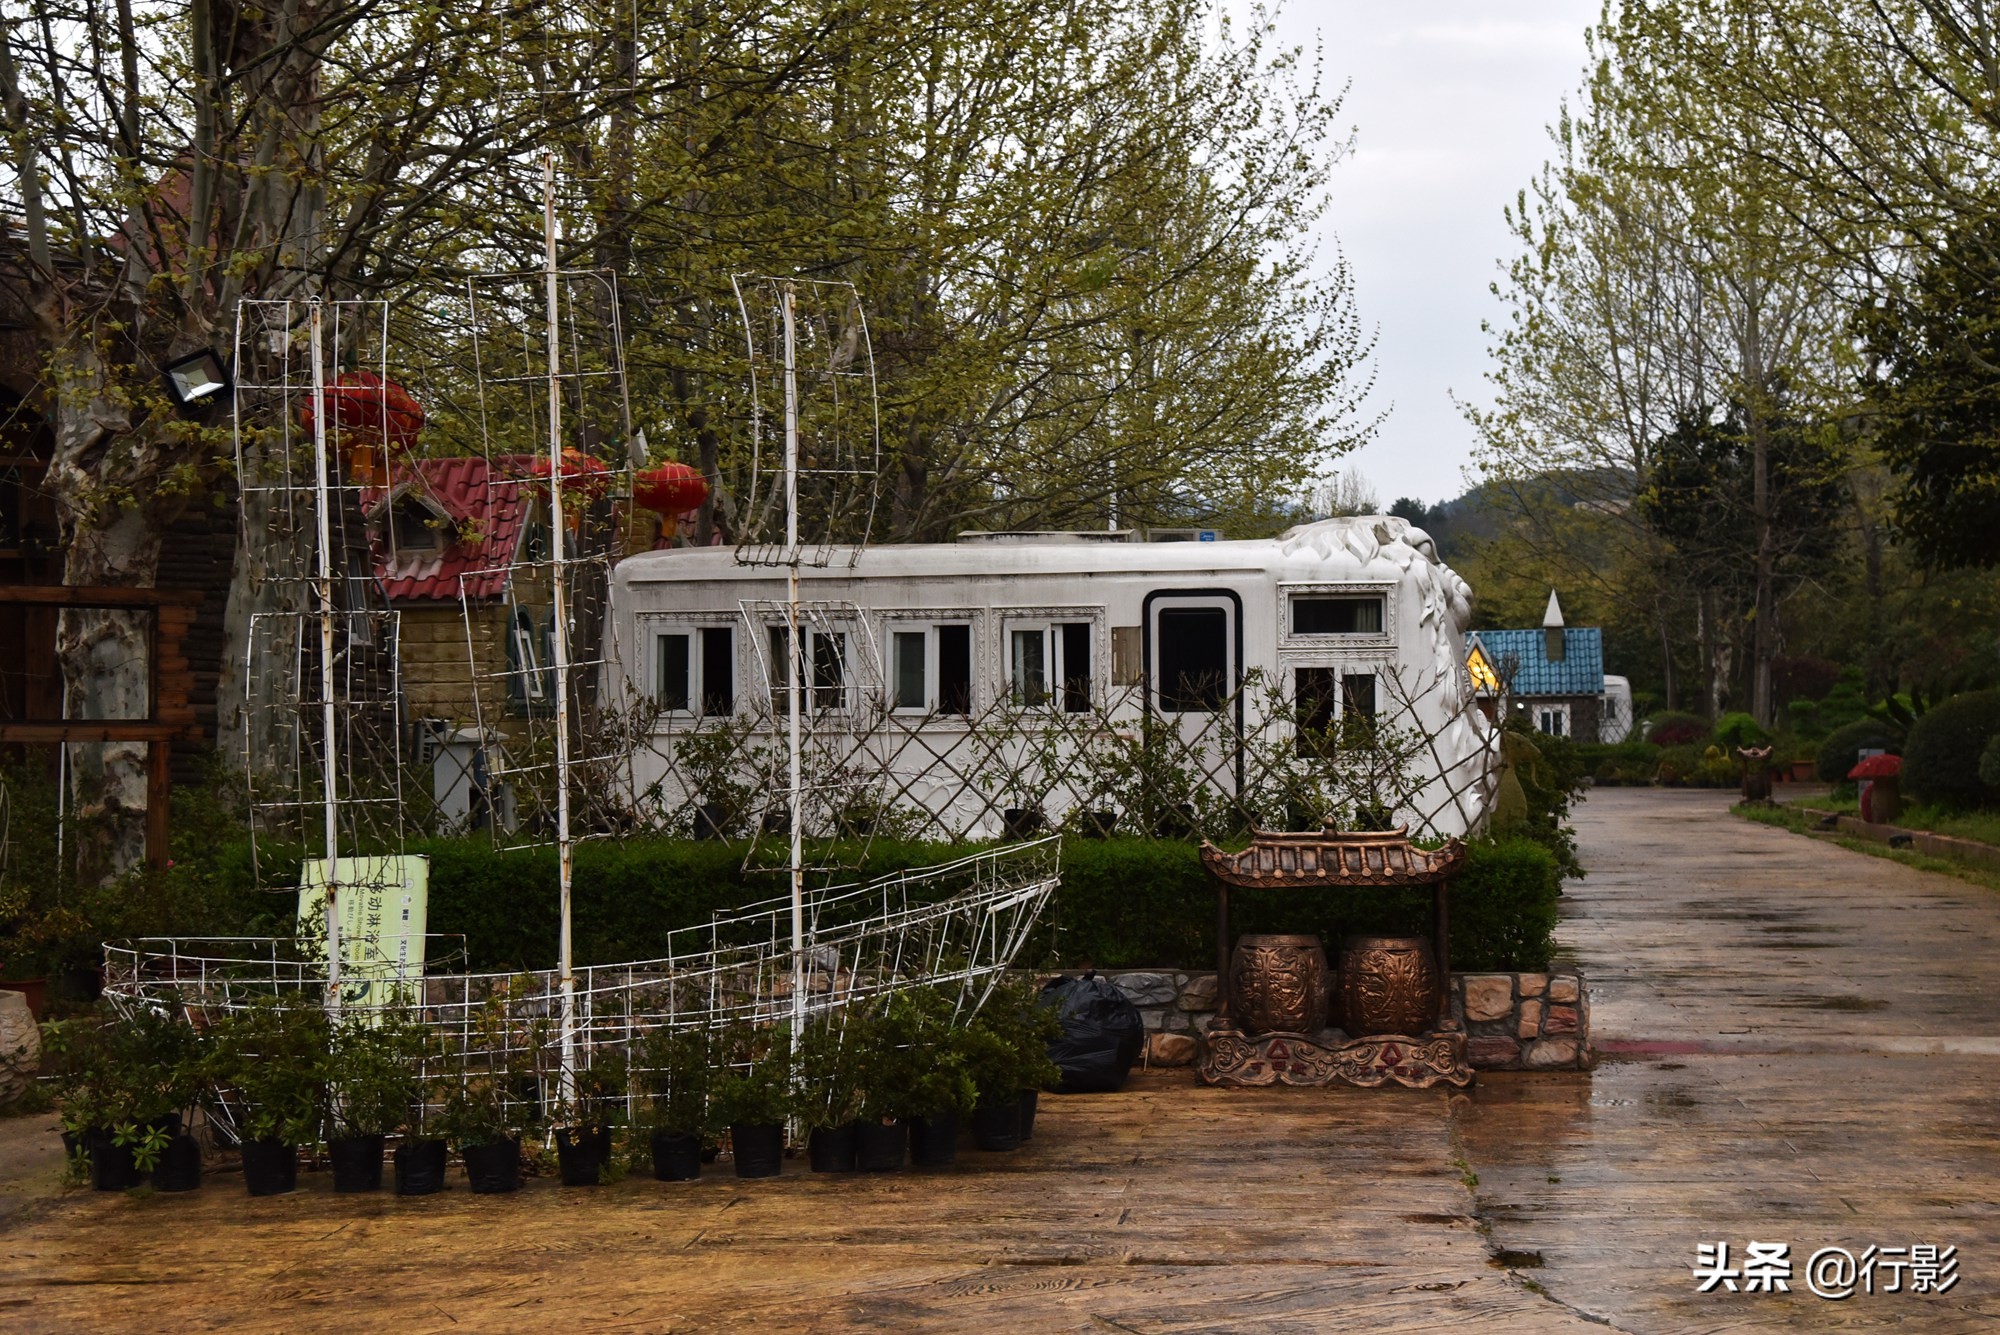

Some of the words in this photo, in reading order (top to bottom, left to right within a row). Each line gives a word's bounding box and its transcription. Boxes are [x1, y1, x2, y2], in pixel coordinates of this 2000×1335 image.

[364, 883, 383, 960] 移动淋浴室
